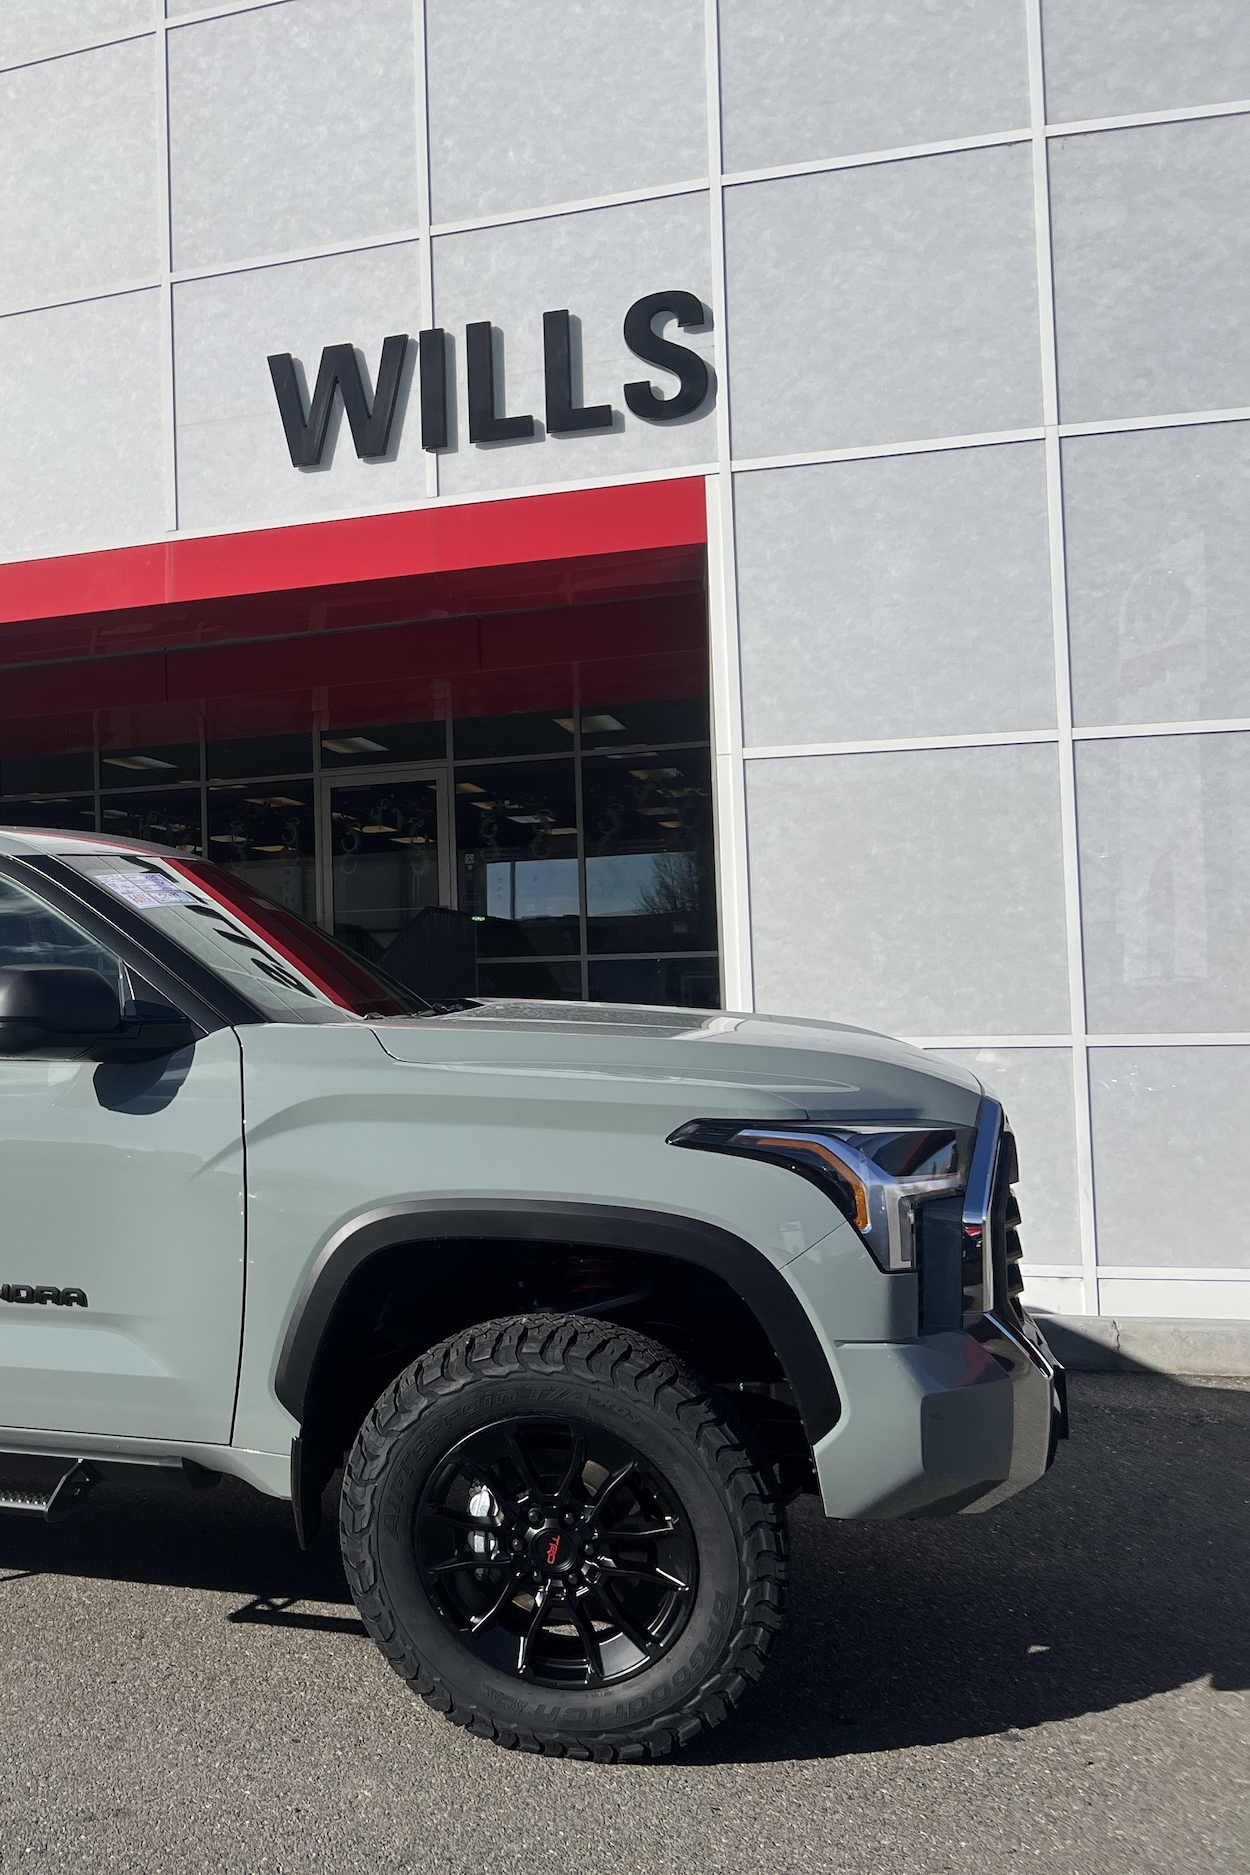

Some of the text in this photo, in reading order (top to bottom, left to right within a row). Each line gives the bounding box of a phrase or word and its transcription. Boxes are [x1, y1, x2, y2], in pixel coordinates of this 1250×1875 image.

[266, 290, 711, 468] WILLS
[382, 1389, 519, 1542] All-Terrain
[547, 1535, 560, 1564] TRD
[533, 1590, 733, 1725] BFGoodrich
